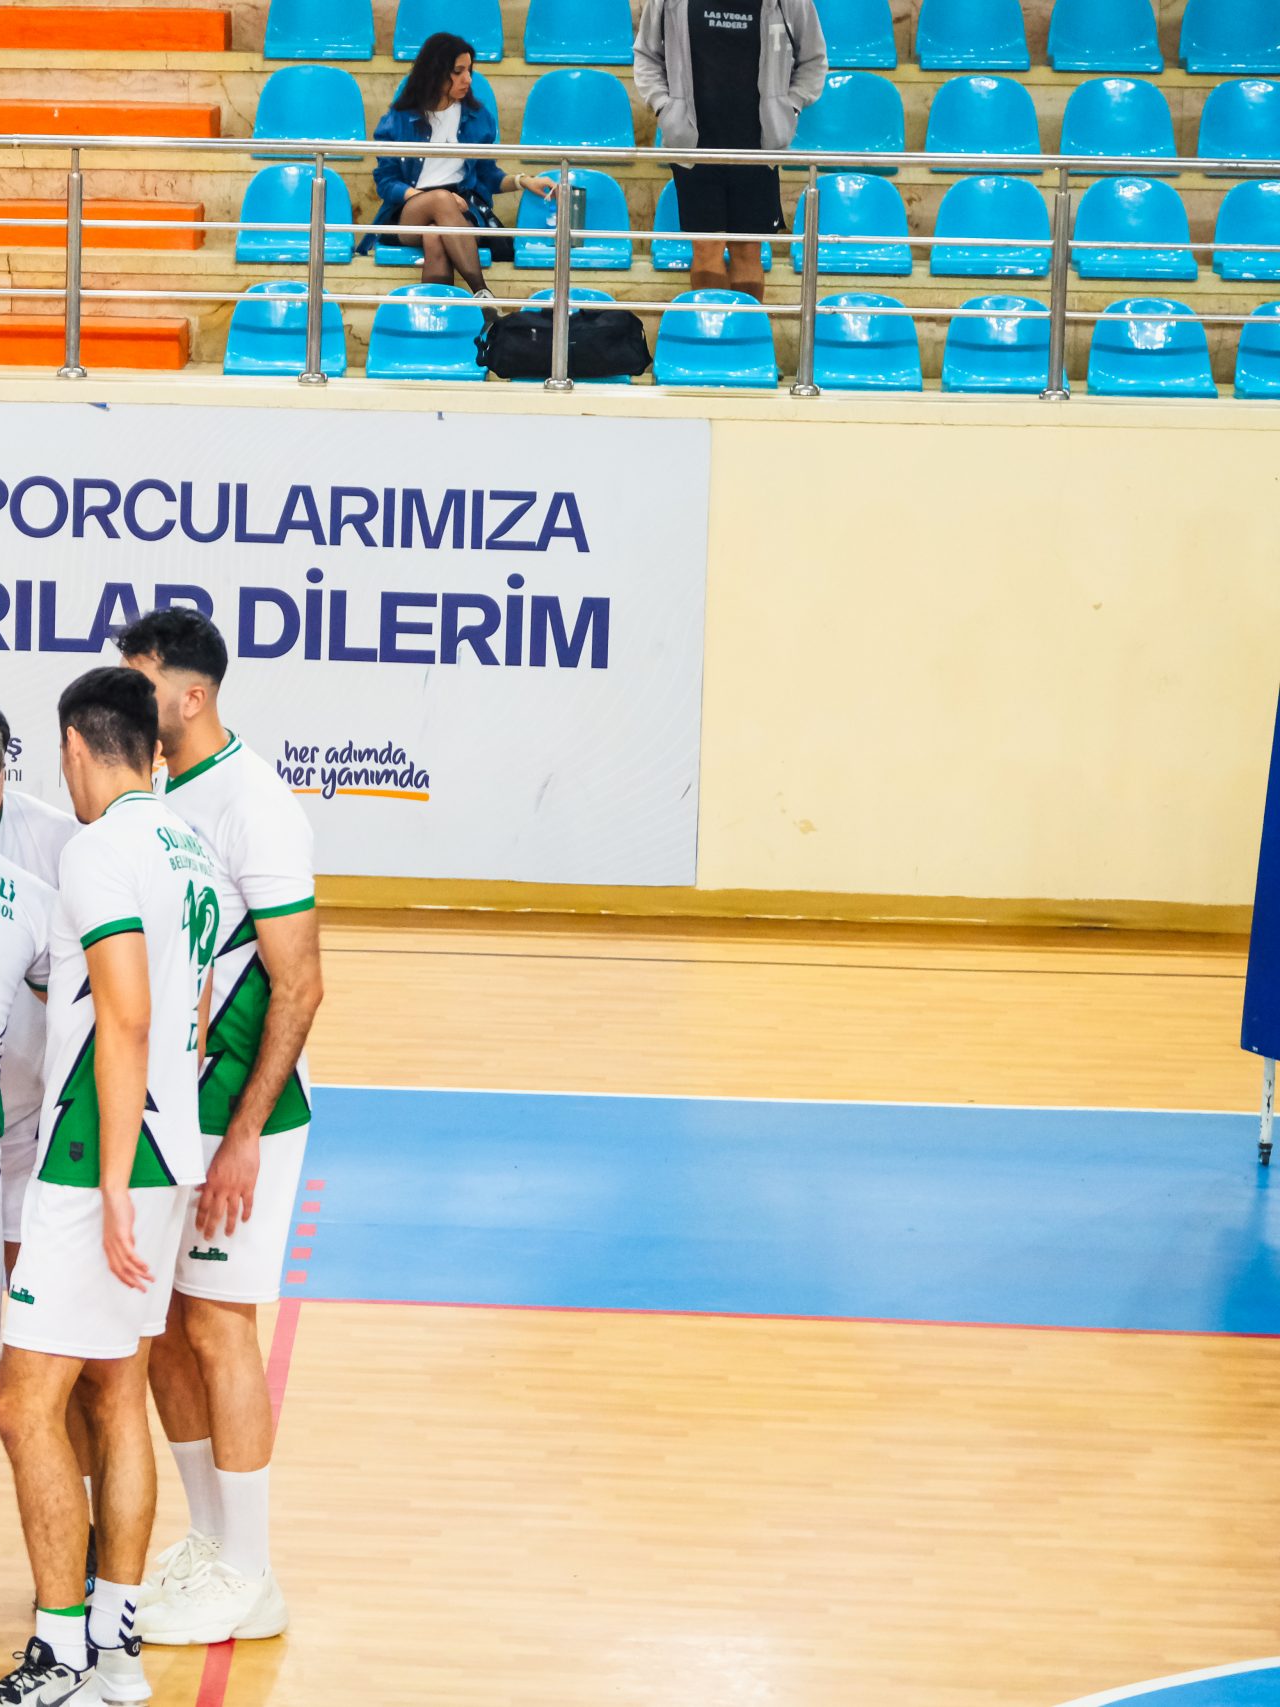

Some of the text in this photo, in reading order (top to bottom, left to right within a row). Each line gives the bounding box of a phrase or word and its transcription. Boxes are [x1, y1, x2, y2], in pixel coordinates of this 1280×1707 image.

[704, 10, 753, 22] LAS VEGAS
[708, 20, 748, 30] RAIDERS
[237, 567, 611, 669] DİLERİM
[284, 740, 406, 766] her adımda
[276, 759, 430, 800] her yanımda
